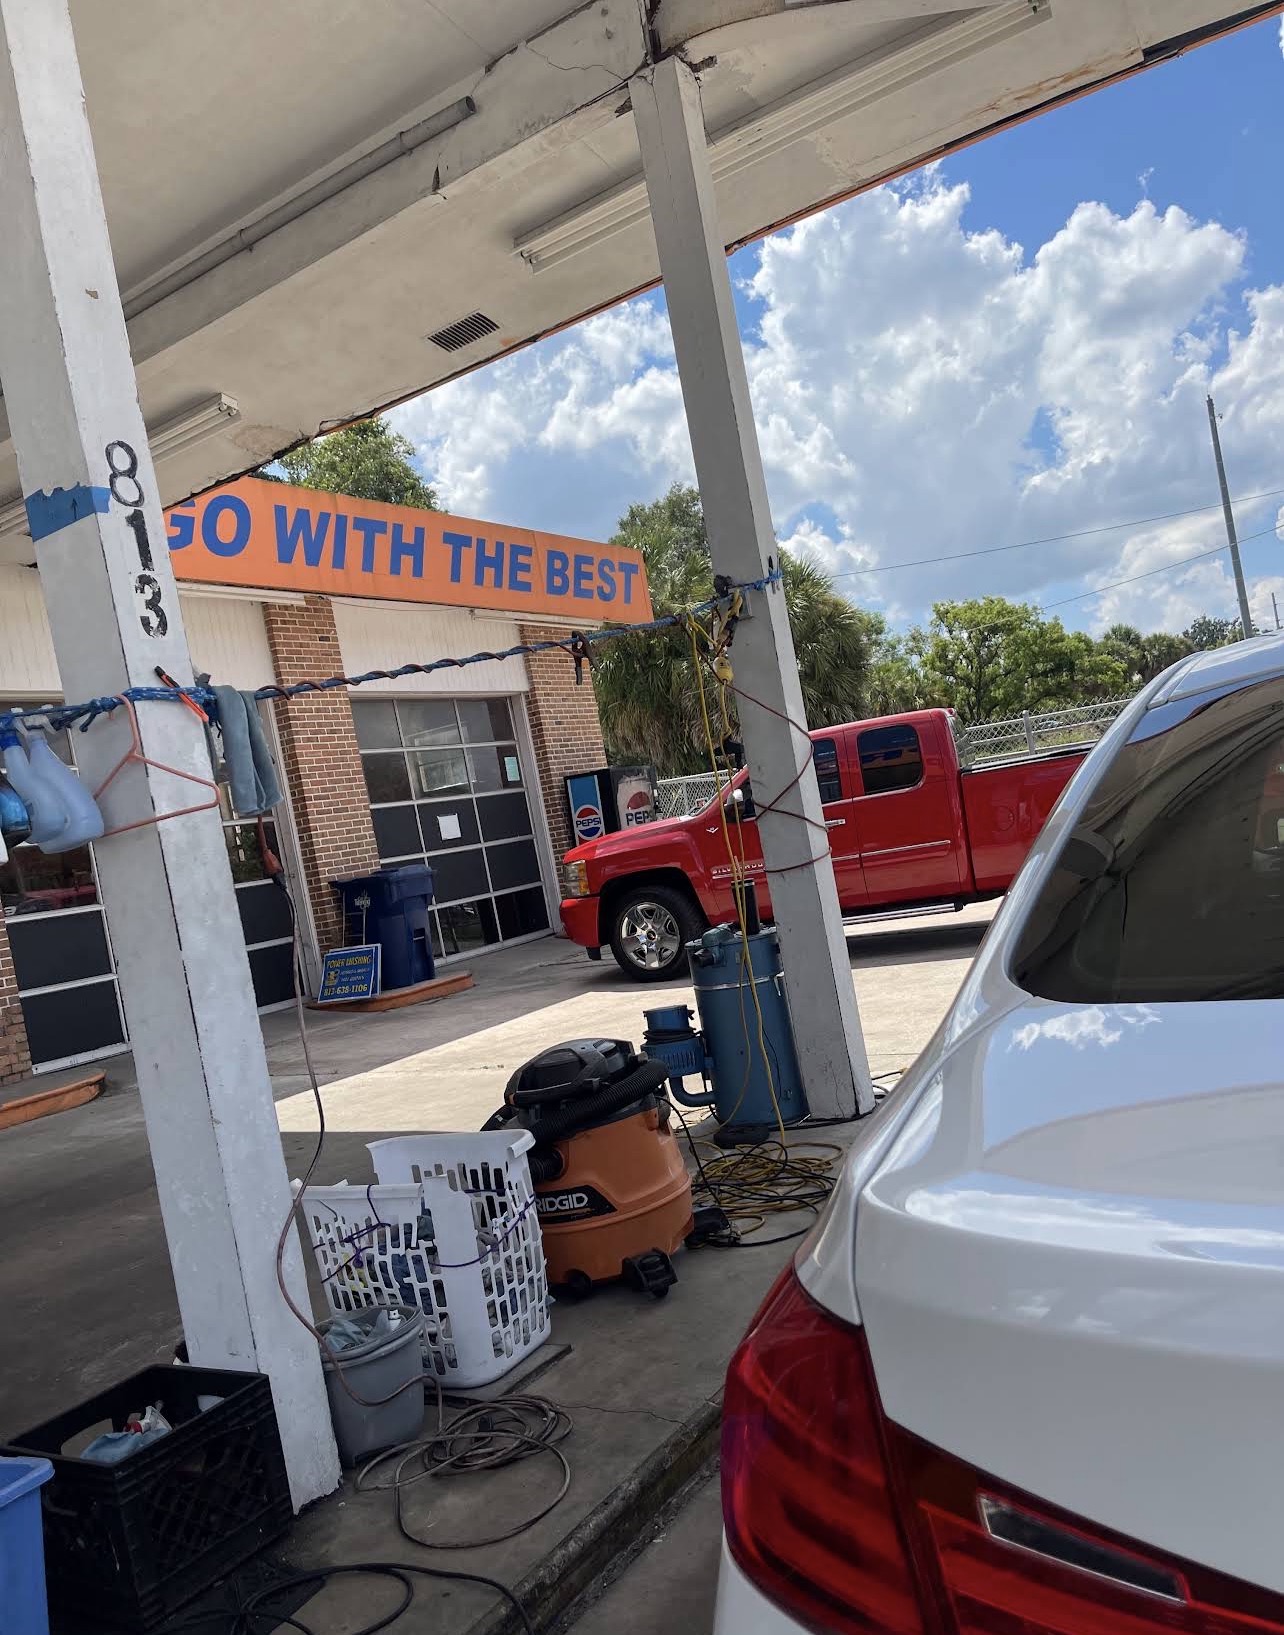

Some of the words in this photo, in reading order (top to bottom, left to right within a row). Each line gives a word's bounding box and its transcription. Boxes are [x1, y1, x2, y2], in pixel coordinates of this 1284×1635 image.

[168, 494, 251, 557] GO
[274, 504, 425, 578] WITH
[443, 531, 532, 592] THE
[546, 550, 638, 604] BEST
[576, 816, 602, 828] PEPSI
[712, 862, 764, 875] SILVADO
[323, 983, 368, 996] 813-638-1106
[535, 1192, 588, 1213] RIDGID
